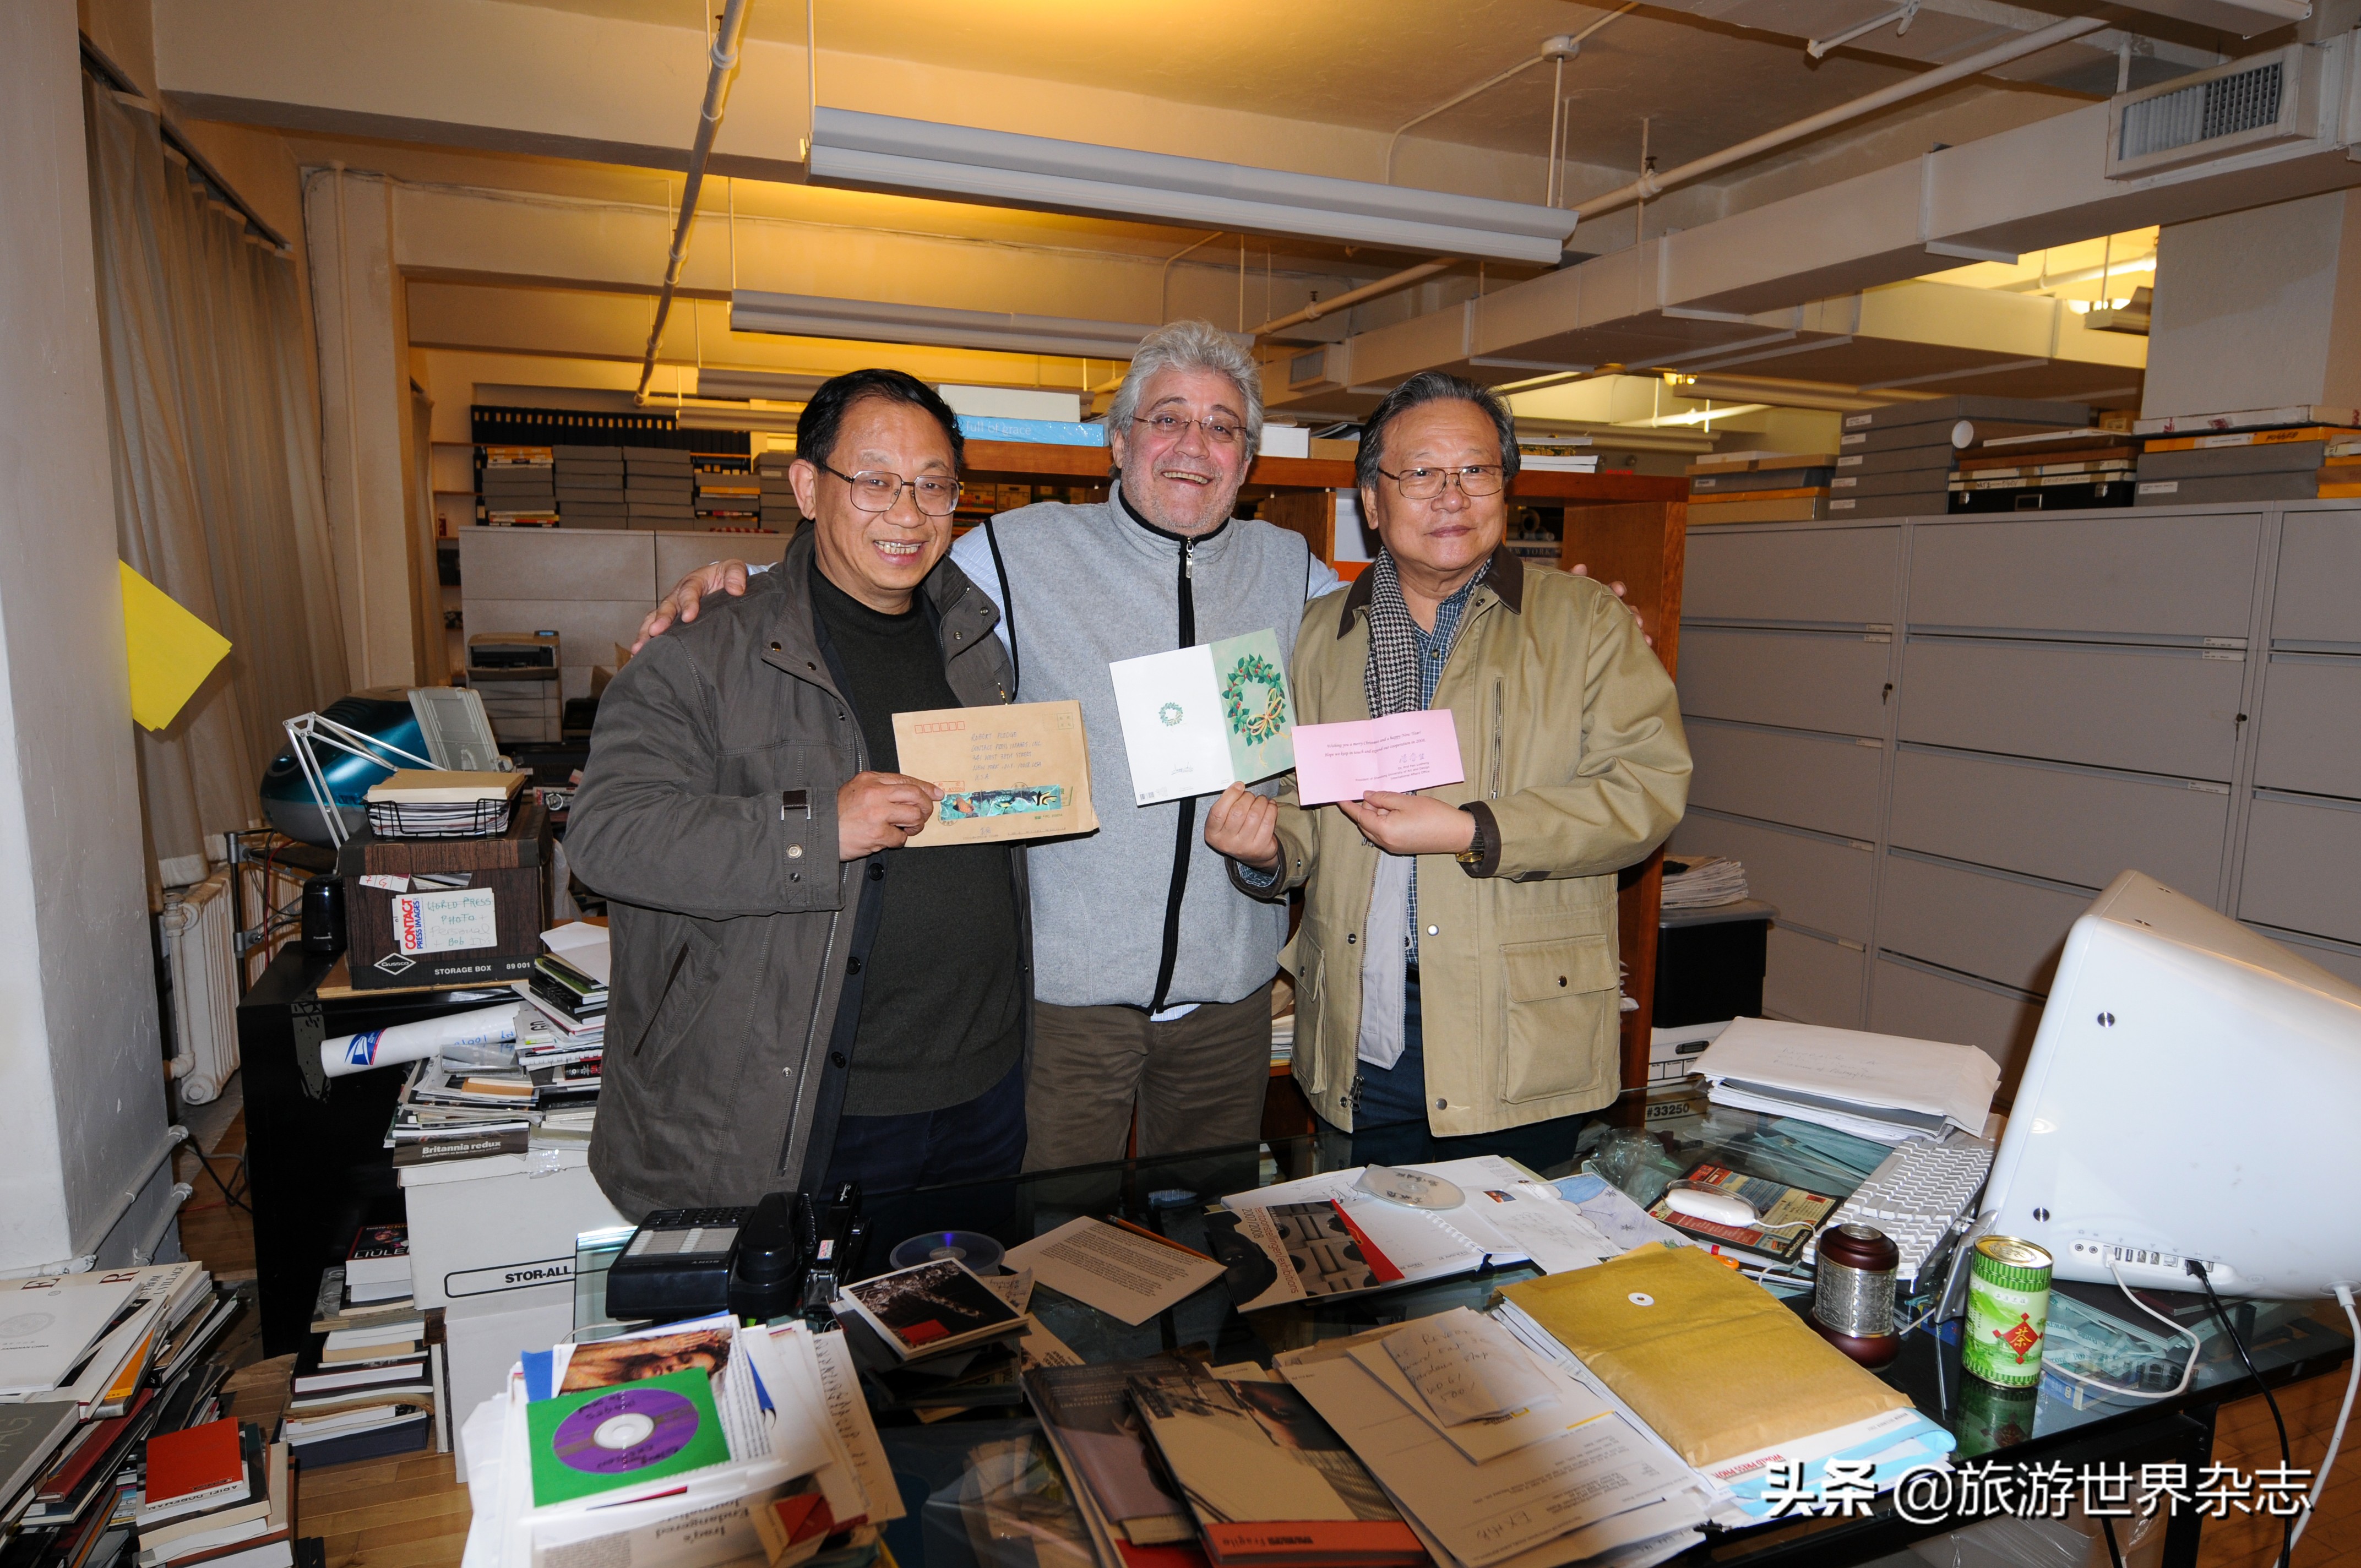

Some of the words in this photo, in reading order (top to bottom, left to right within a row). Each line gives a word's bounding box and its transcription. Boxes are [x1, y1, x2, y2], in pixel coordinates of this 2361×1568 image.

[966, 421, 983, 432] full
[988, 422, 999, 433] of
[1002, 424, 1031, 436] grace
[427, 900, 458, 912] WORLD
[463, 897, 492, 908] PRESS
[413, 900, 421, 928] IMAGES
[401, 899, 416, 950] CONTACT
[430, 923, 491, 937] Personal
[448, 937, 464, 946] Bob
[434, 967, 473, 975] STORAGE
[1647, 1102, 1690, 1118] #33250
[422, 1143, 470, 1154] Britannia
[471, 1141, 502, 1150] redux
[1242, 1208, 1264, 1239] 2007/2008
[505, 1265, 572, 1284] STOR-ALL
[2010, 1326, 2033, 1347] 茶
[1734, 1460, 1758, 1474] PRESS
[1757, 1453, 1784, 1468] WORLD
[656, 1506, 749, 1539] Endangered
